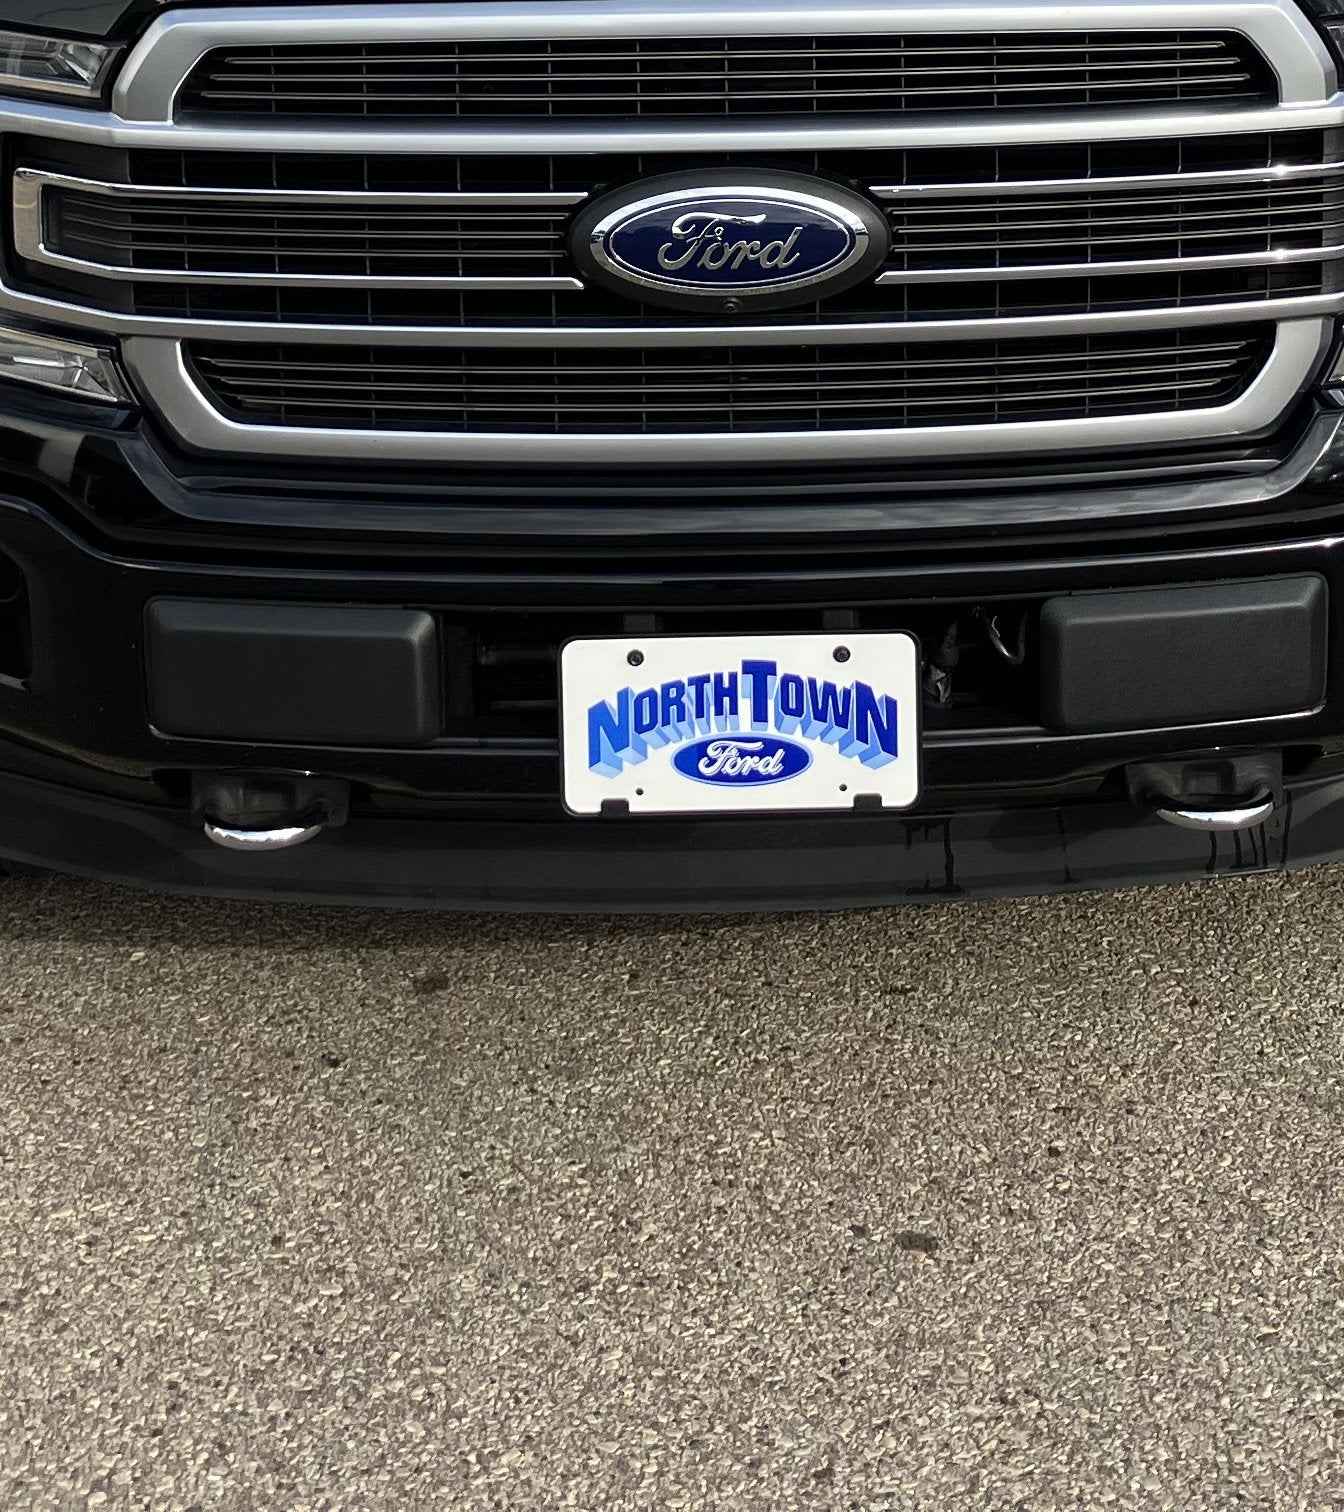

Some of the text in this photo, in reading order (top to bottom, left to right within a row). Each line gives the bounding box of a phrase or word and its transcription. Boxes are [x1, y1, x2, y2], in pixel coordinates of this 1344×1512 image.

[657, 210, 804, 271] Ford
[587, 659, 899, 778] NORTHTOWN
[696, 739, 785, 777] Ford
